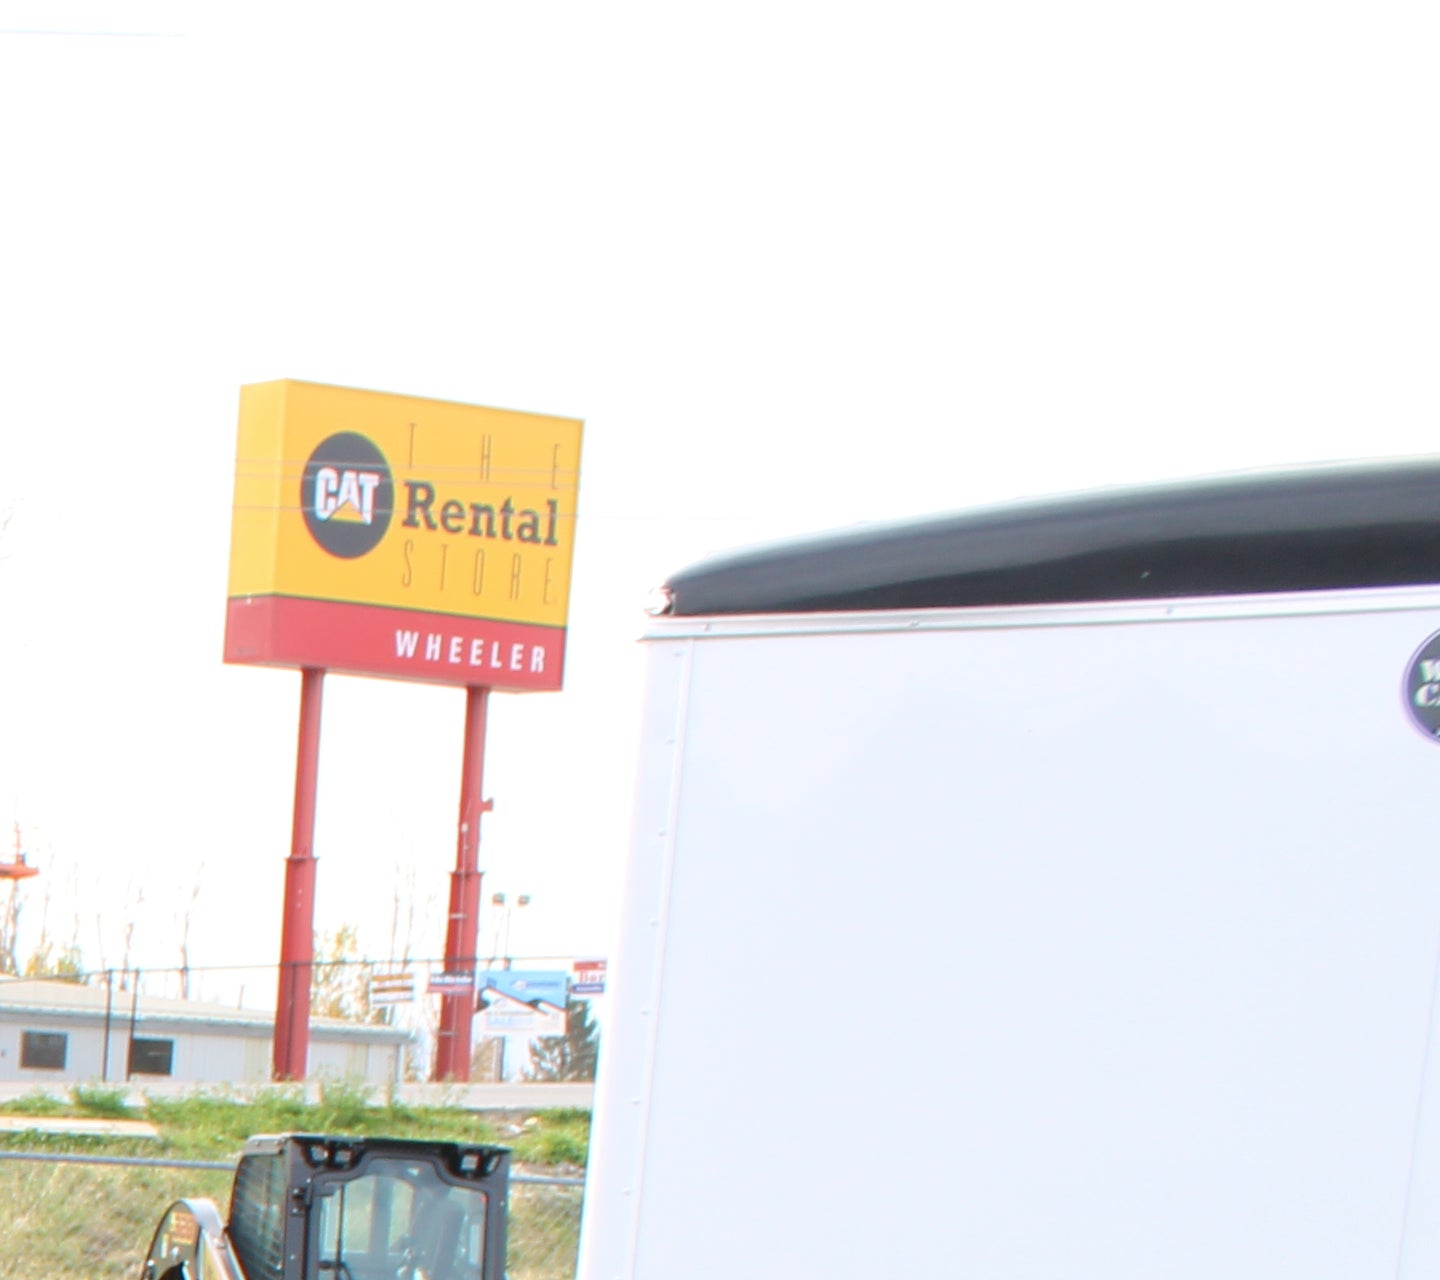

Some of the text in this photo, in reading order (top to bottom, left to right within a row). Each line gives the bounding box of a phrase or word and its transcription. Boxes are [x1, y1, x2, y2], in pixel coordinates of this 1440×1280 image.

[409, 423, 560, 490] THE
[314, 467, 380, 525] CAT
[402, 480, 559, 546] Rental
[402, 540, 553, 604] STORE
[396, 629, 546, 673] WHEELER
